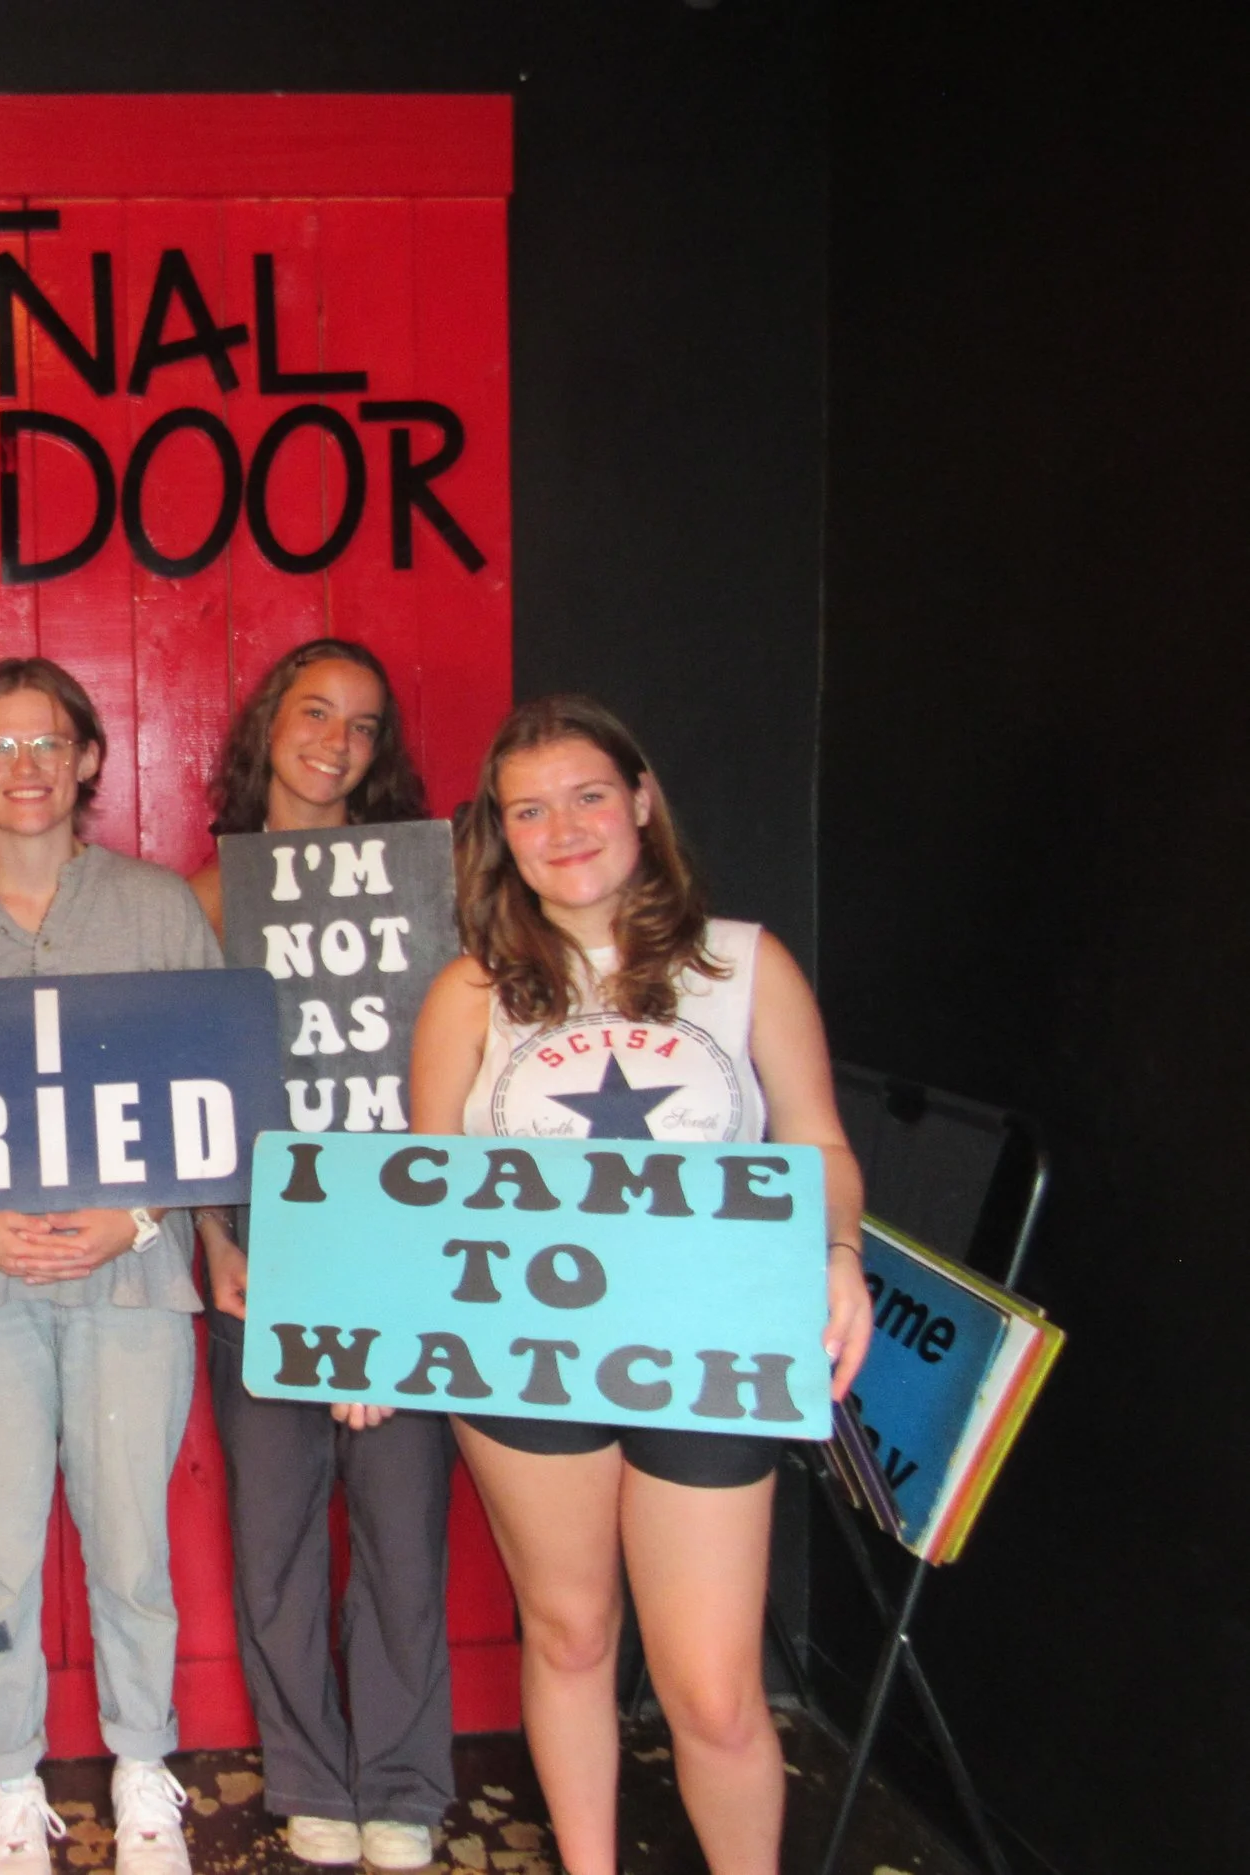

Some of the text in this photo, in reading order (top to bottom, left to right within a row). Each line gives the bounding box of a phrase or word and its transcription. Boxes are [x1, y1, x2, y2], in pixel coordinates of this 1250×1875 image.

[0, 400, 488, 585] DOOR
[270, 838, 394, 901] I'M
[261, 916, 410, 979] NOT
[34, 988, 62, 1074] I
[290, 996, 391, 1056] AS
[536, 1028, 681, 1069] SCISA
[284, 1075, 409, 1132] UM
[279, 1142, 795, 1221] I CAME
[442, 1239, 608, 1310] TO
[863, 1271, 957, 1365] ame
[270, 1323, 805, 1423] WATCH
